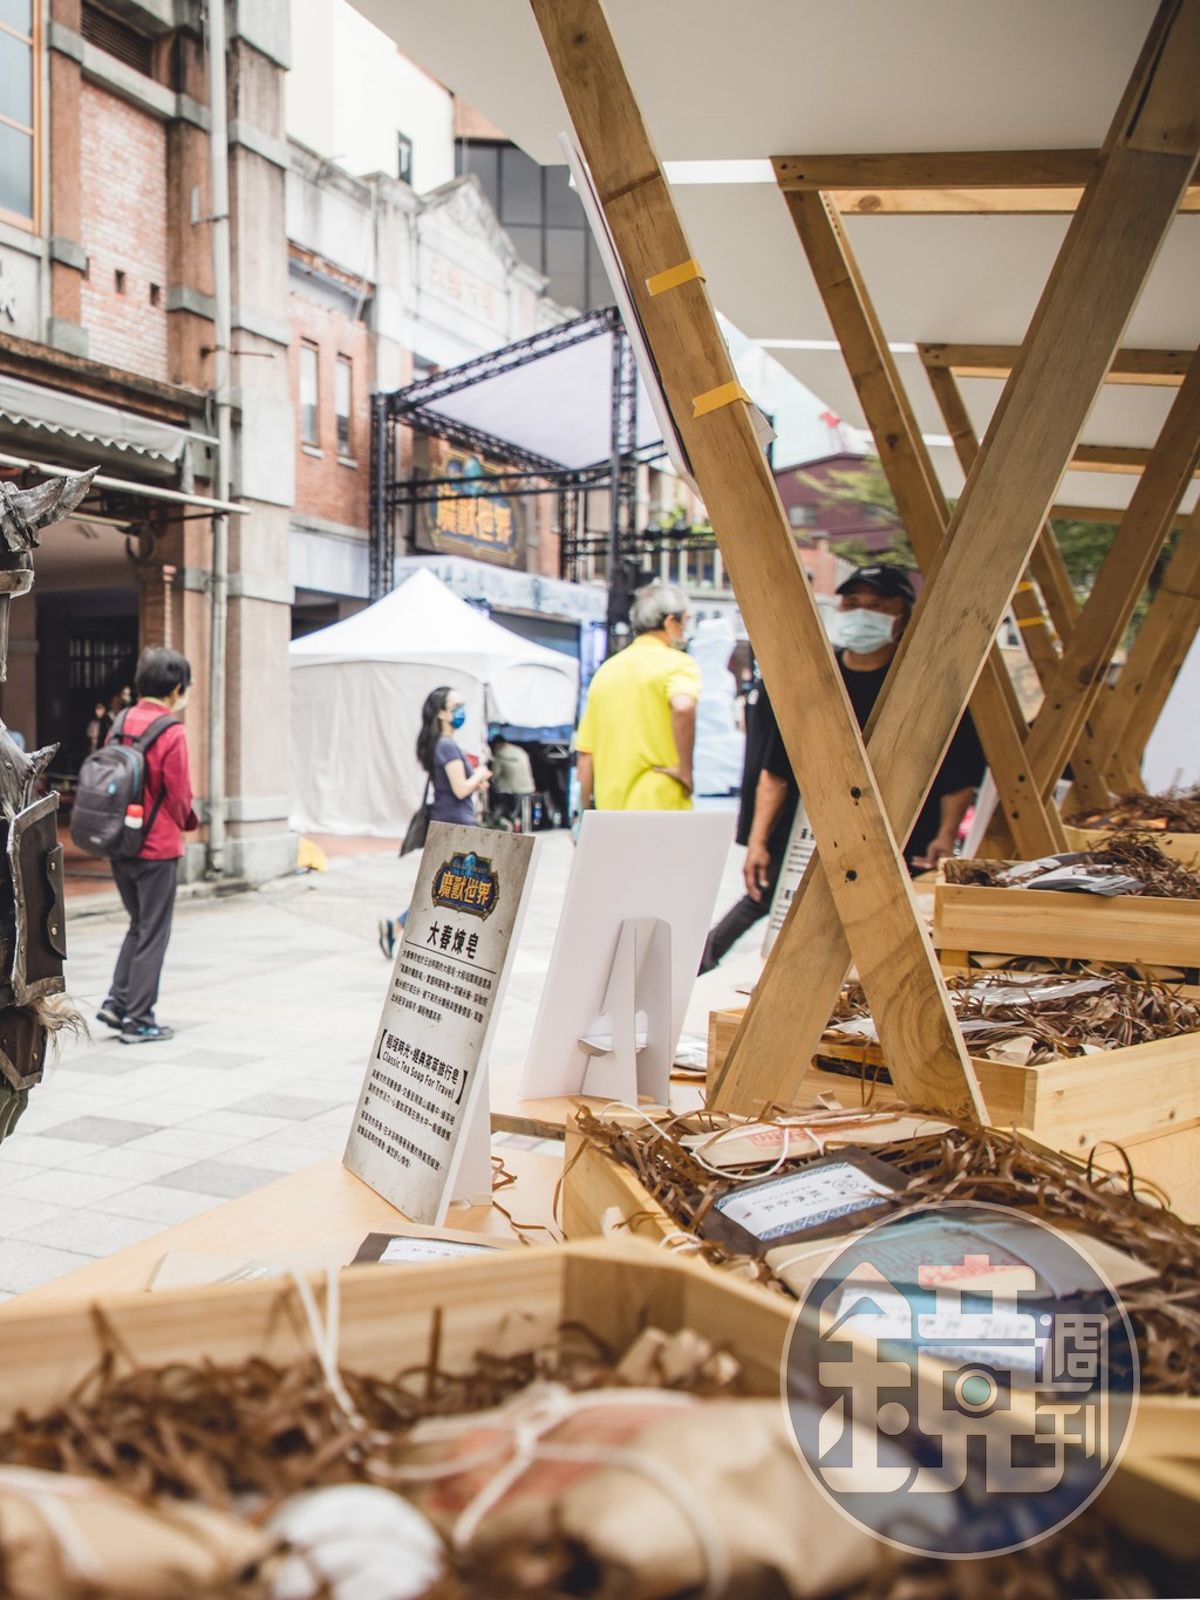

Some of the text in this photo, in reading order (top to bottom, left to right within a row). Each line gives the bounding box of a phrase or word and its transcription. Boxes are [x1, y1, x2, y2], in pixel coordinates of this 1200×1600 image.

[439, 871, 492, 905] 魔獸世界
[427, 921, 479, 959] 大春煉皂
[382, 1051, 455, 1099] Classic Tea Soap For Travel
